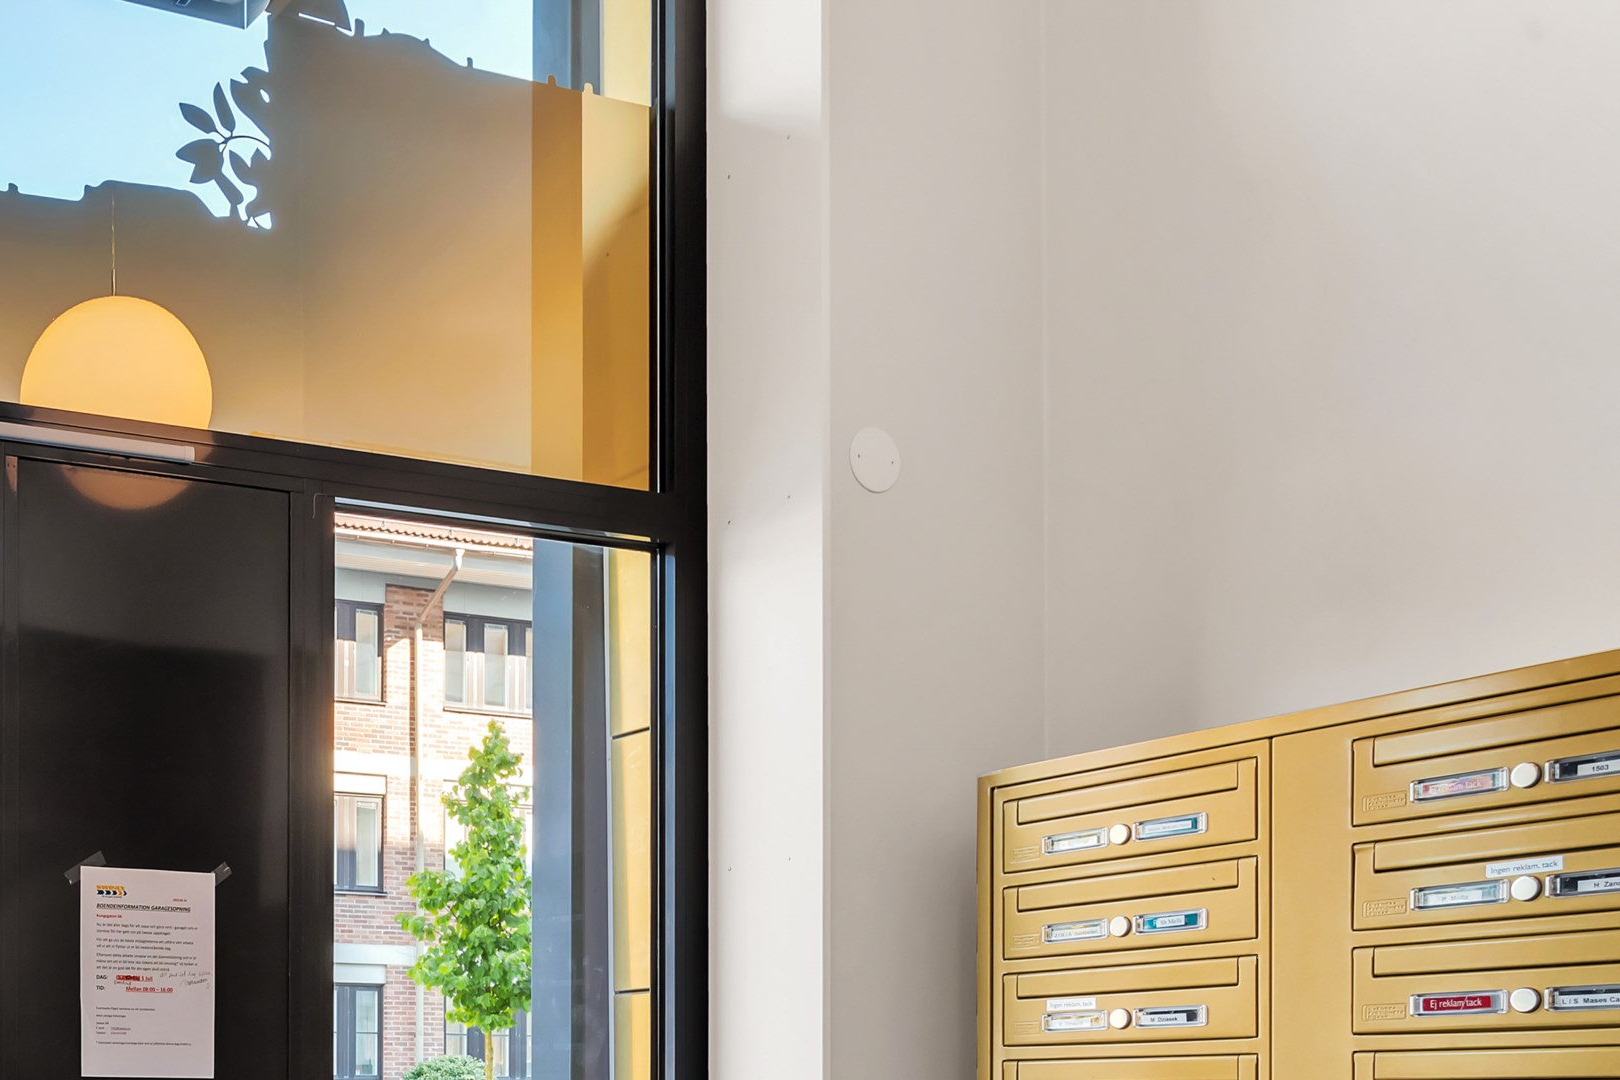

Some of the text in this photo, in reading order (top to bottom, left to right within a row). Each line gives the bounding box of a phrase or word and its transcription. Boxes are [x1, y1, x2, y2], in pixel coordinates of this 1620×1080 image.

[1592, 764, 1609, 772] 1503
[1490, 867, 1511, 875] Ingen
[96, 903, 191, 913] BOENDEINFORMATION GARAGESOPNING
[1430, 998, 1482, 1010] Ej reklam tack
